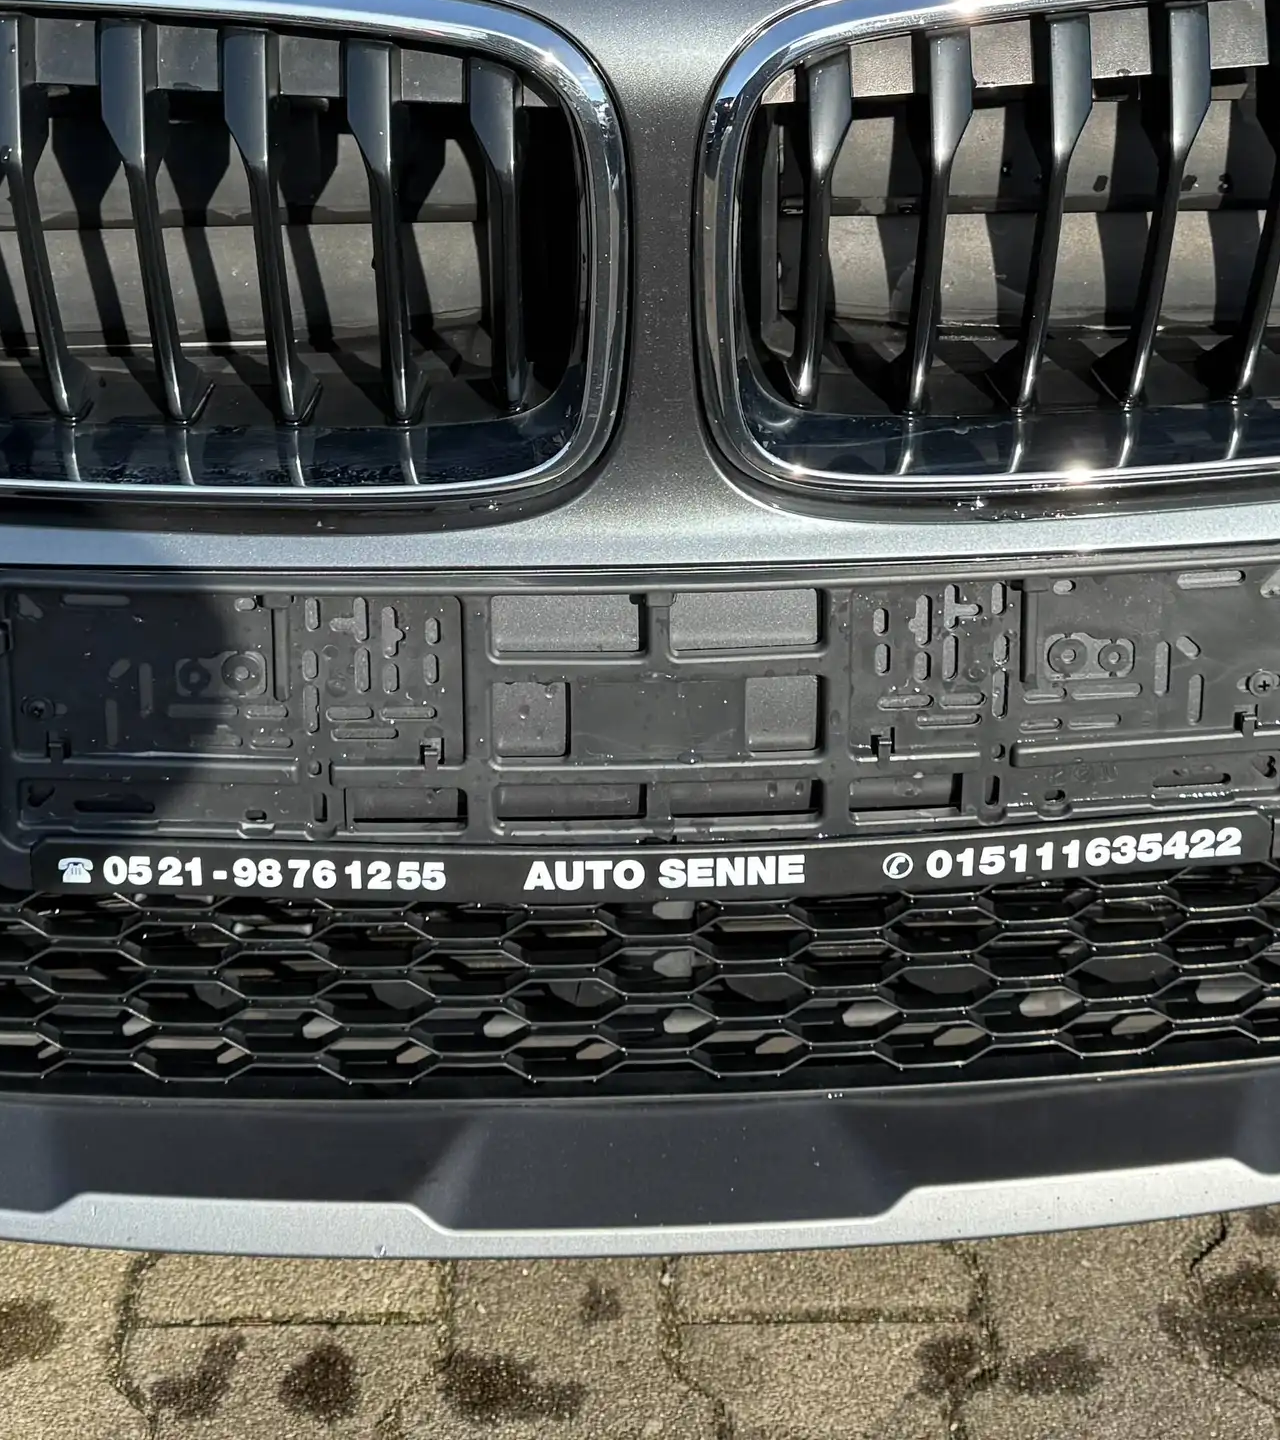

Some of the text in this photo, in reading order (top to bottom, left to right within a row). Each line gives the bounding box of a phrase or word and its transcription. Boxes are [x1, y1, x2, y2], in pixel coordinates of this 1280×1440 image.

[103, 826, 1242, 891] 0521-98761255 AUTO SENNE 015111635422
